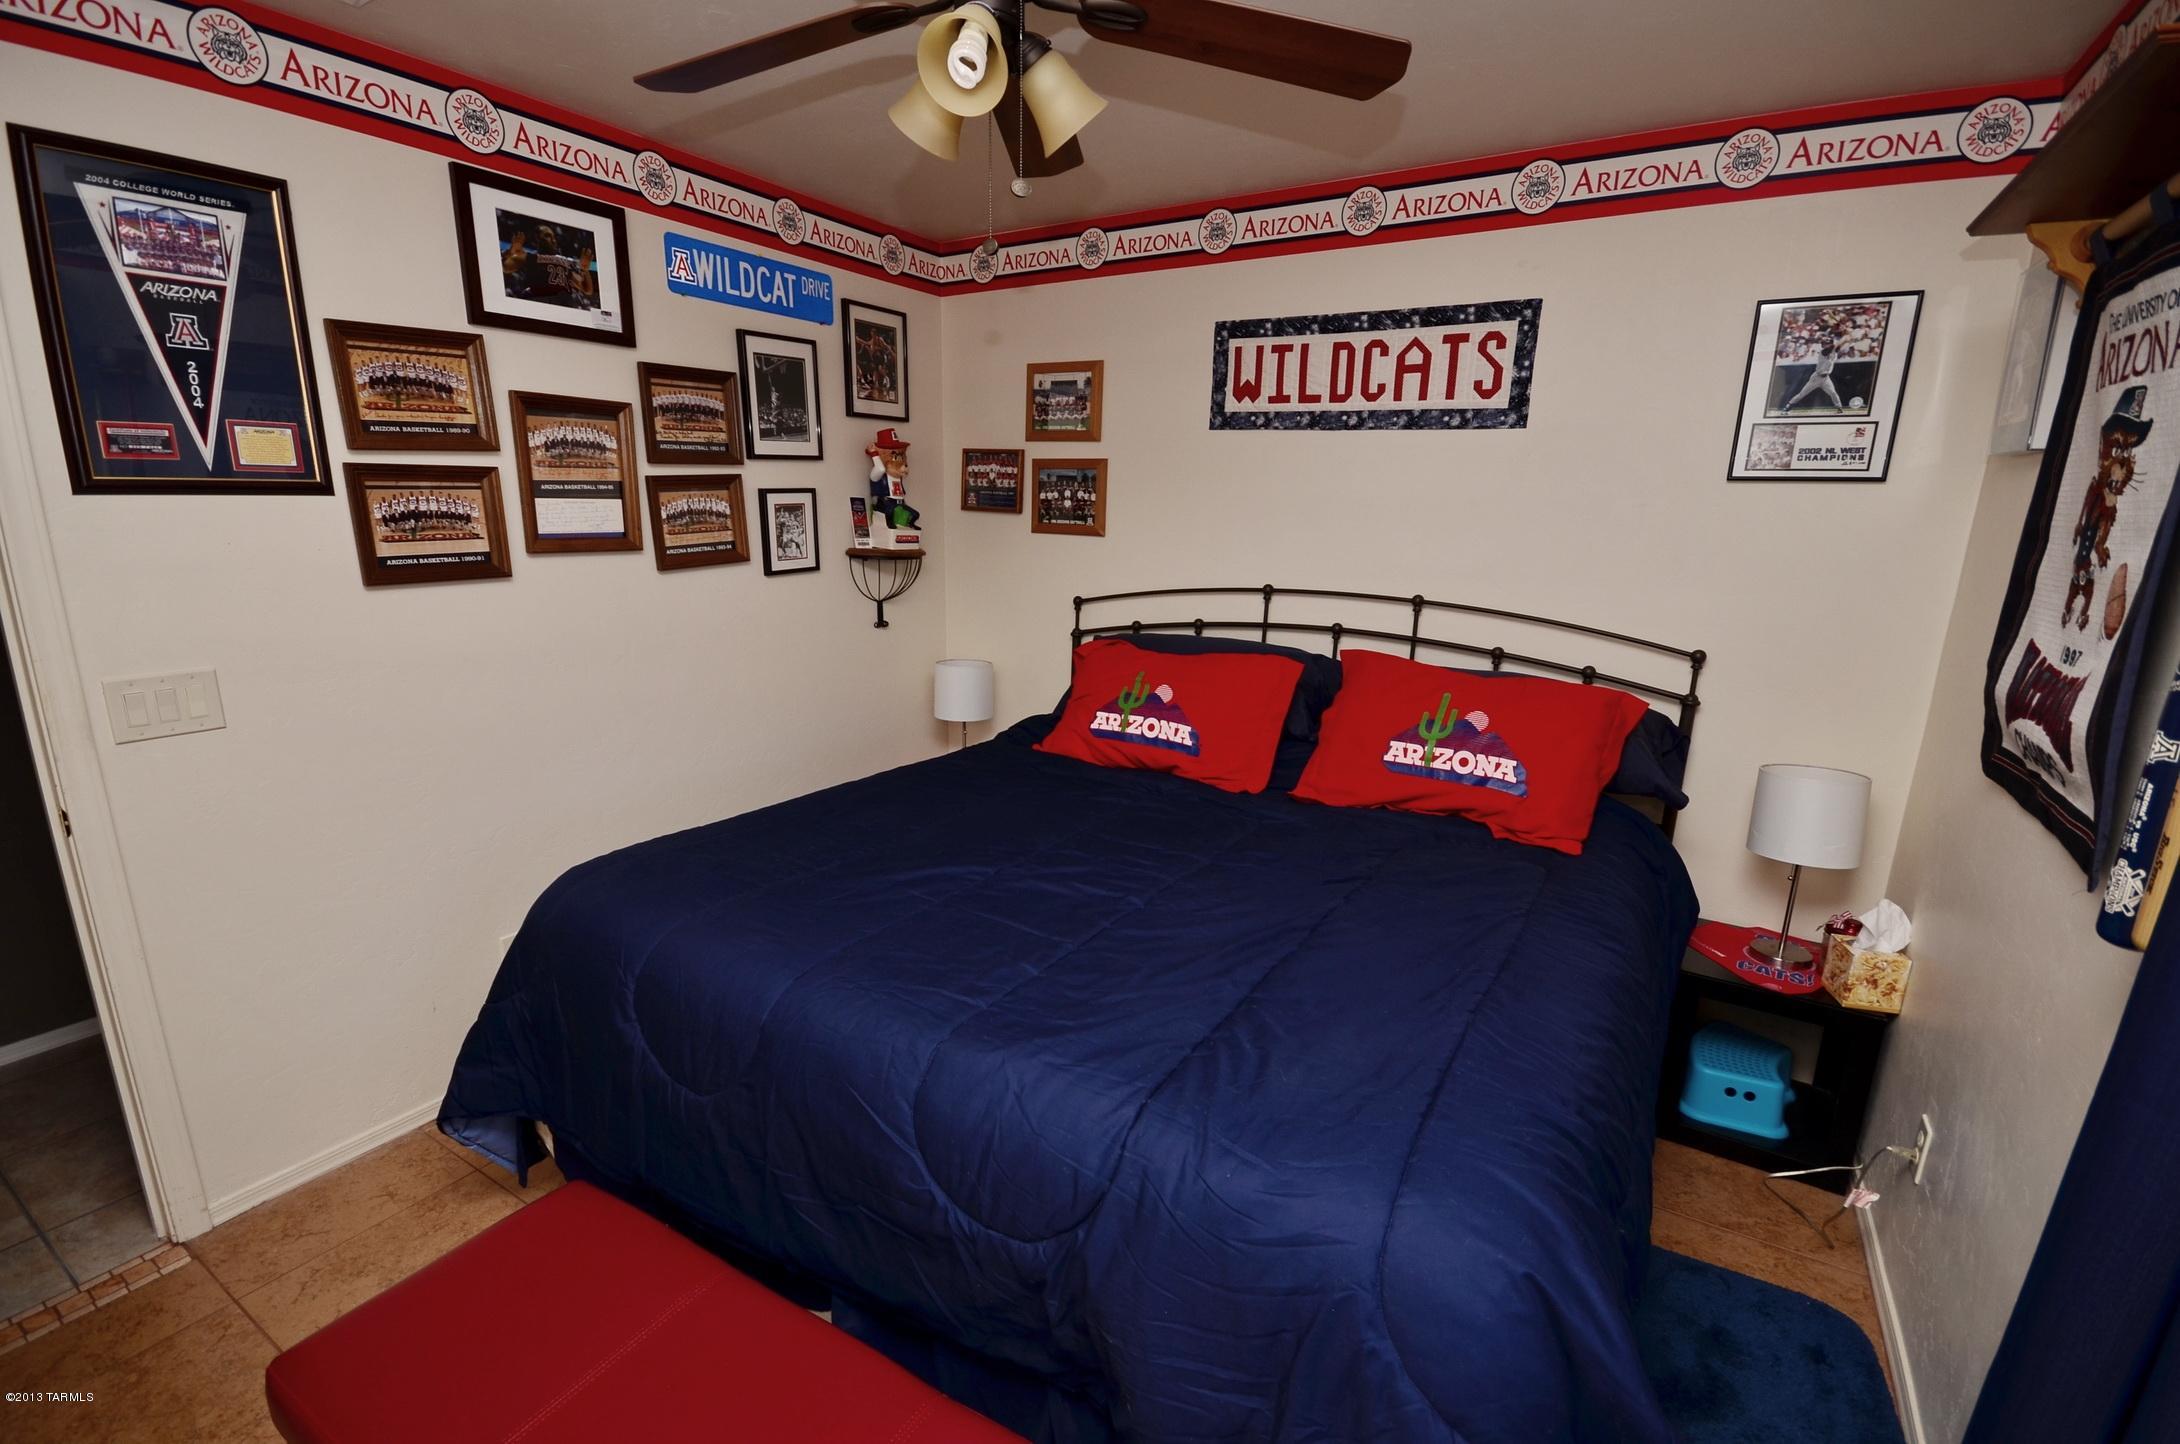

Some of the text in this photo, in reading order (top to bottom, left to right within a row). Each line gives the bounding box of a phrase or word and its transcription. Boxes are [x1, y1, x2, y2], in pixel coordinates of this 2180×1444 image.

[0, 0, 176, 49] IZONA
[199, 14, 257, 50] ARIZONA
[199, 42, 261, 79] WILDCATS
[280, 48, 438, 126] ARIZONA
[452, 94, 496, 124] ARIZONA
[1968, 103, 2021, 131] ARIZONA
[454, 117, 499, 148] WILDCATS
[1724, 133, 1773, 159] ARIZONA
[1966, 128, 2023, 156] WILDCATS
[513, 121, 628, 183] ARIZONA
[1786, 130, 1944, 168] ARIZONA
[638, 156, 671, 181] ARIZONA
[1519, 165, 1559, 188] ARIZONA
[1571, 159, 1704, 195] ARIZONA
[1722, 156, 1772, 182] WILDCATS
[85, 174, 110, 185] 2004
[113, 179, 158, 194] COLLEGE
[162, 187, 196, 201] WORLD
[640, 178, 673, 202] WILDCATS
[1346, 191, 1382, 211] ARIZONA
[1518, 184, 1560, 209] WILDCATS
[683, 178, 769, 226] ARIZONA
[1392, 188, 1502, 219] ARIZONA
[1203, 212, 1231, 231] ARIZONA
[1241, 211, 1334, 239] ARIZONA
[1347, 209, 1382, 231] WILDCATS
[810, 219, 875, 259] ARIZONA
[1113, 231, 1192, 256] ARIZONA
[1203, 227, 1233, 250] WILDCATS
[908, 254, 966, 280] ARIZONA
[1002, 248, 1072, 271] ARIZONA
[140, 282, 217, 301] ARIZONA
[669, 247, 830, 308] A WILDCAT DRIVE
[165, 312, 209, 350] A
[1232, 330, 1507, 404] WILDCATS
[186, 361, 204, 409] 2004
[1840, 446, 1867, 454] WEST
[419, 556, 459, 564] BASKETBALL
[2060, 646, 2083, 667] 1997
[1090, 710, 1194, 747] ARIZONA
[1384, 740, 1518, 784] ARIZONA
[1736, 960, 1814, 986] CATS!
